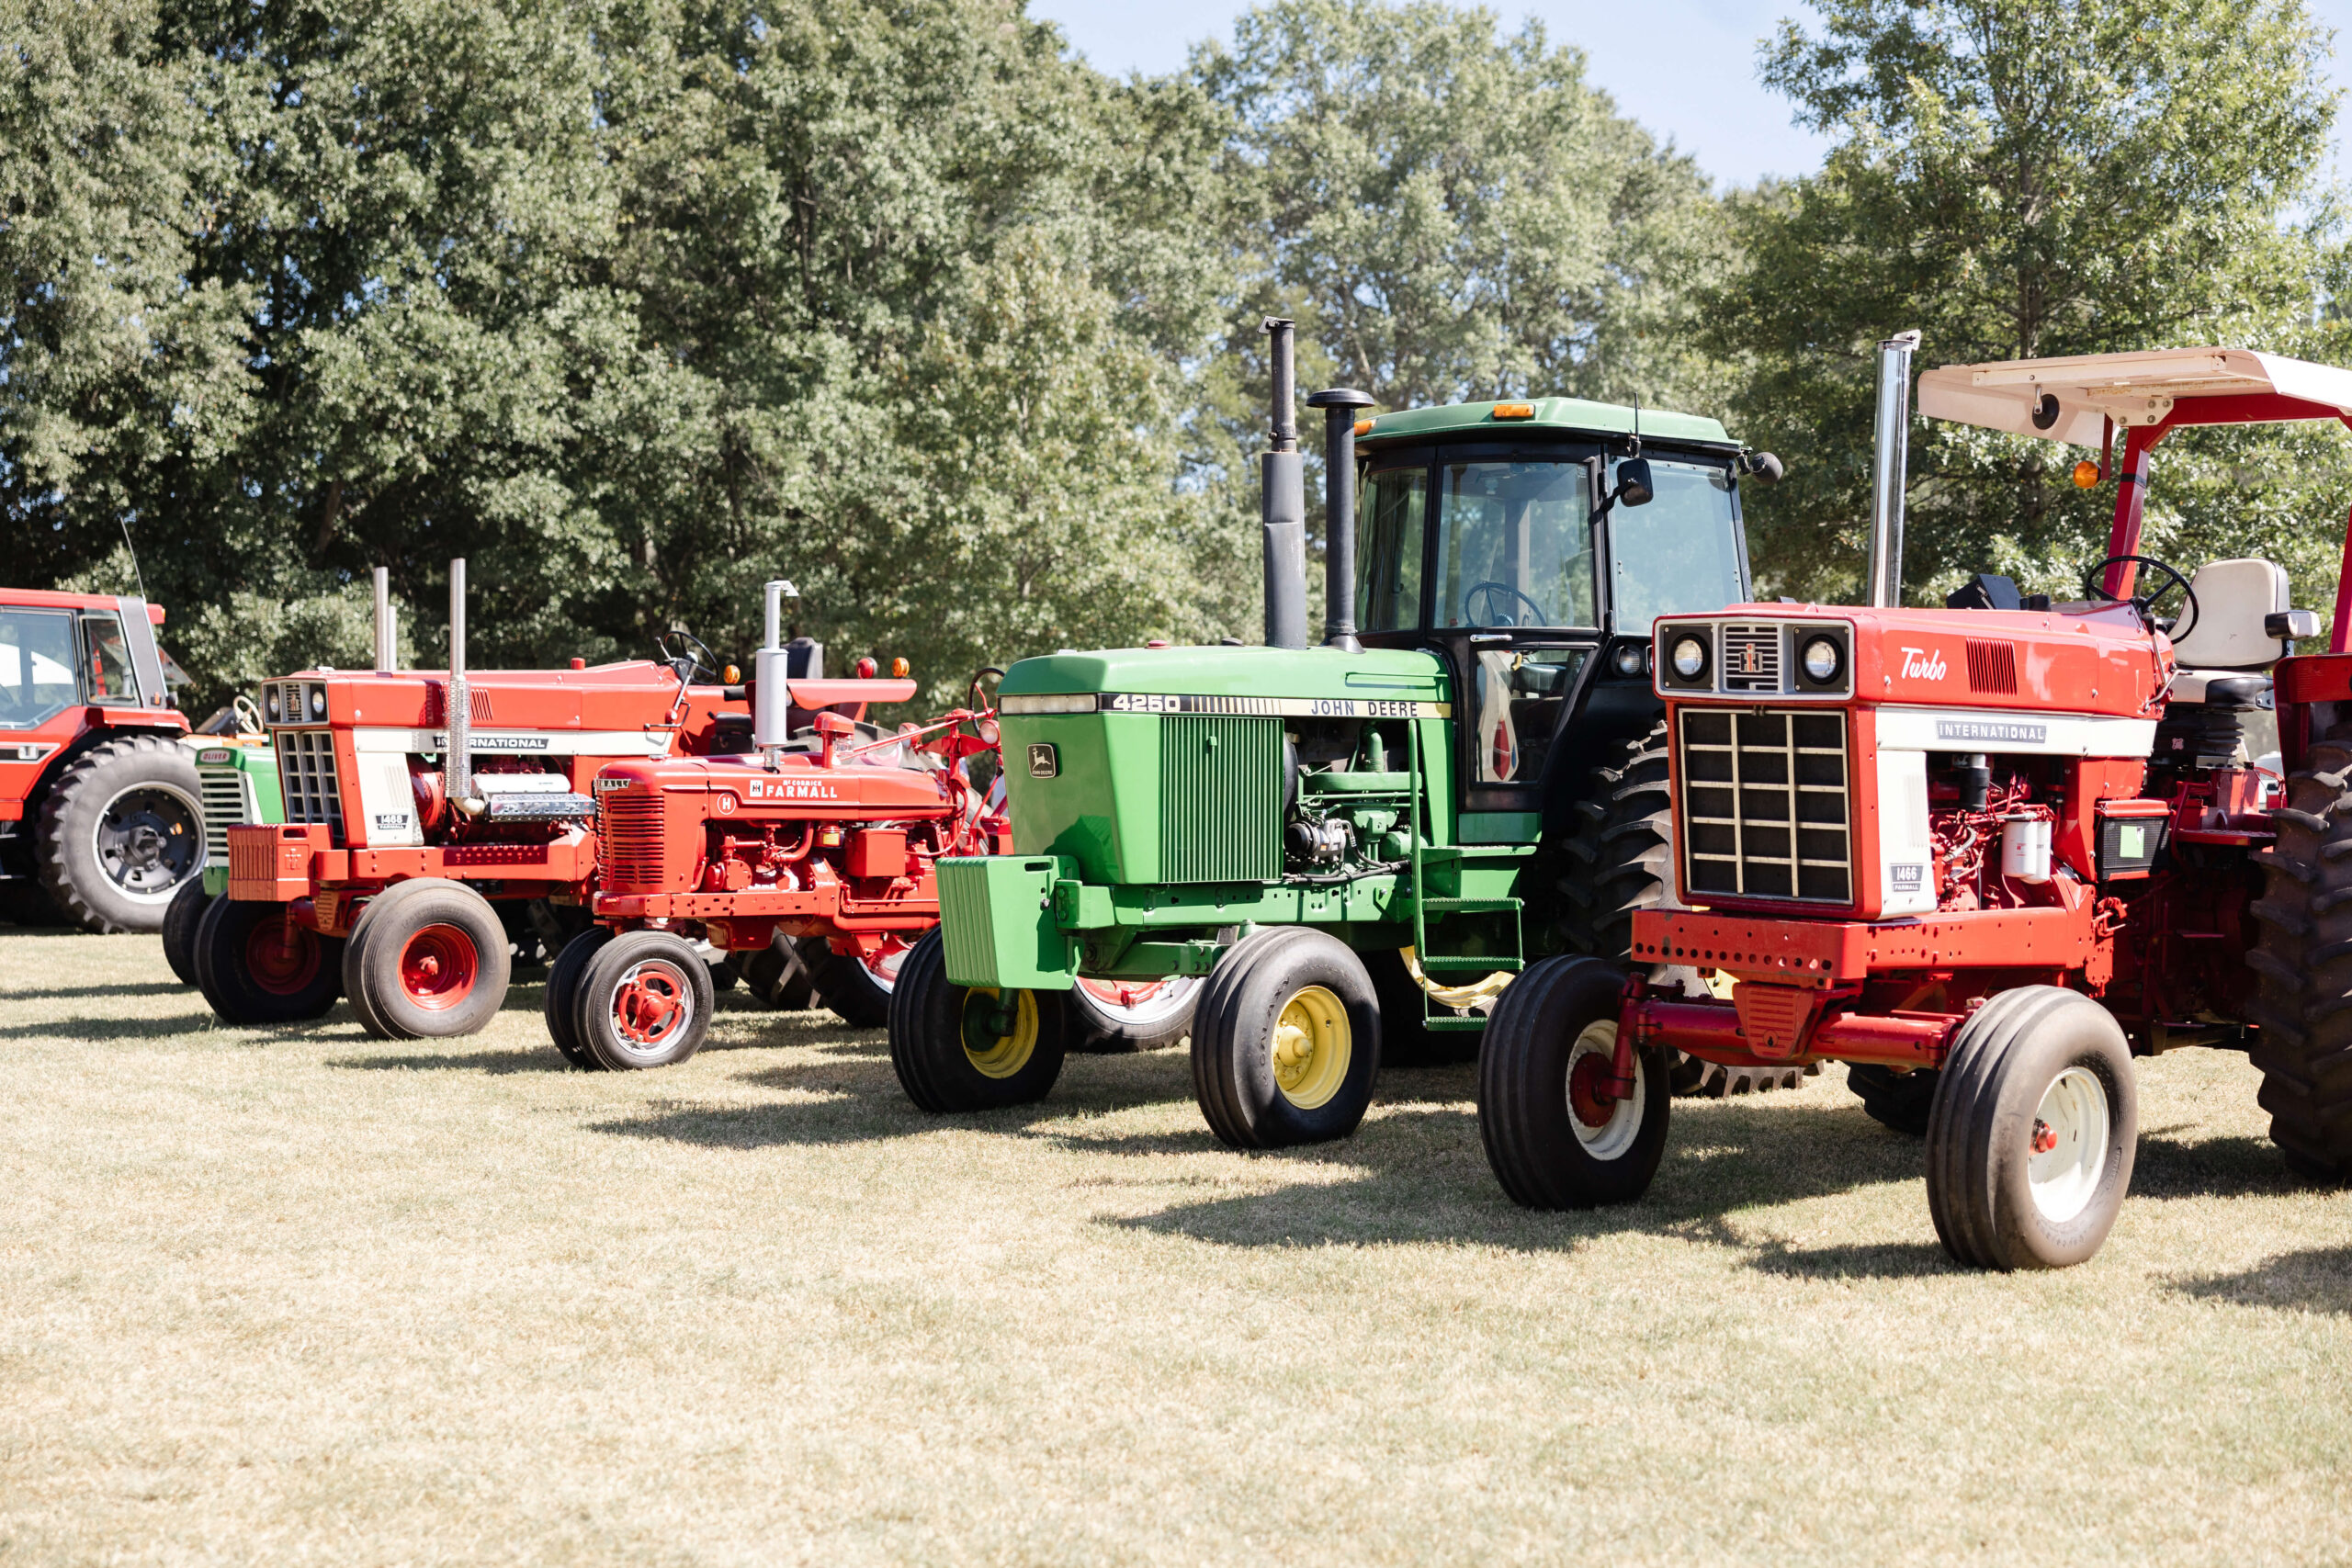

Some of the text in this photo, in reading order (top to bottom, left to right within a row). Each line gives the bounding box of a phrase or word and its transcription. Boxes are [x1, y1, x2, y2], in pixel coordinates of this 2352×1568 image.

[1901, 647, 1947, 681] Turbo
[1113, 694, 1181, 712] 4250
[1311, 701, 1418, 716] JOHN DEERE
[1939, 724, 2044, 740] INTERNATIONAL
[766, 785, 838, 798] FARMALL
[1896, 866, 1917, 881] 1466
